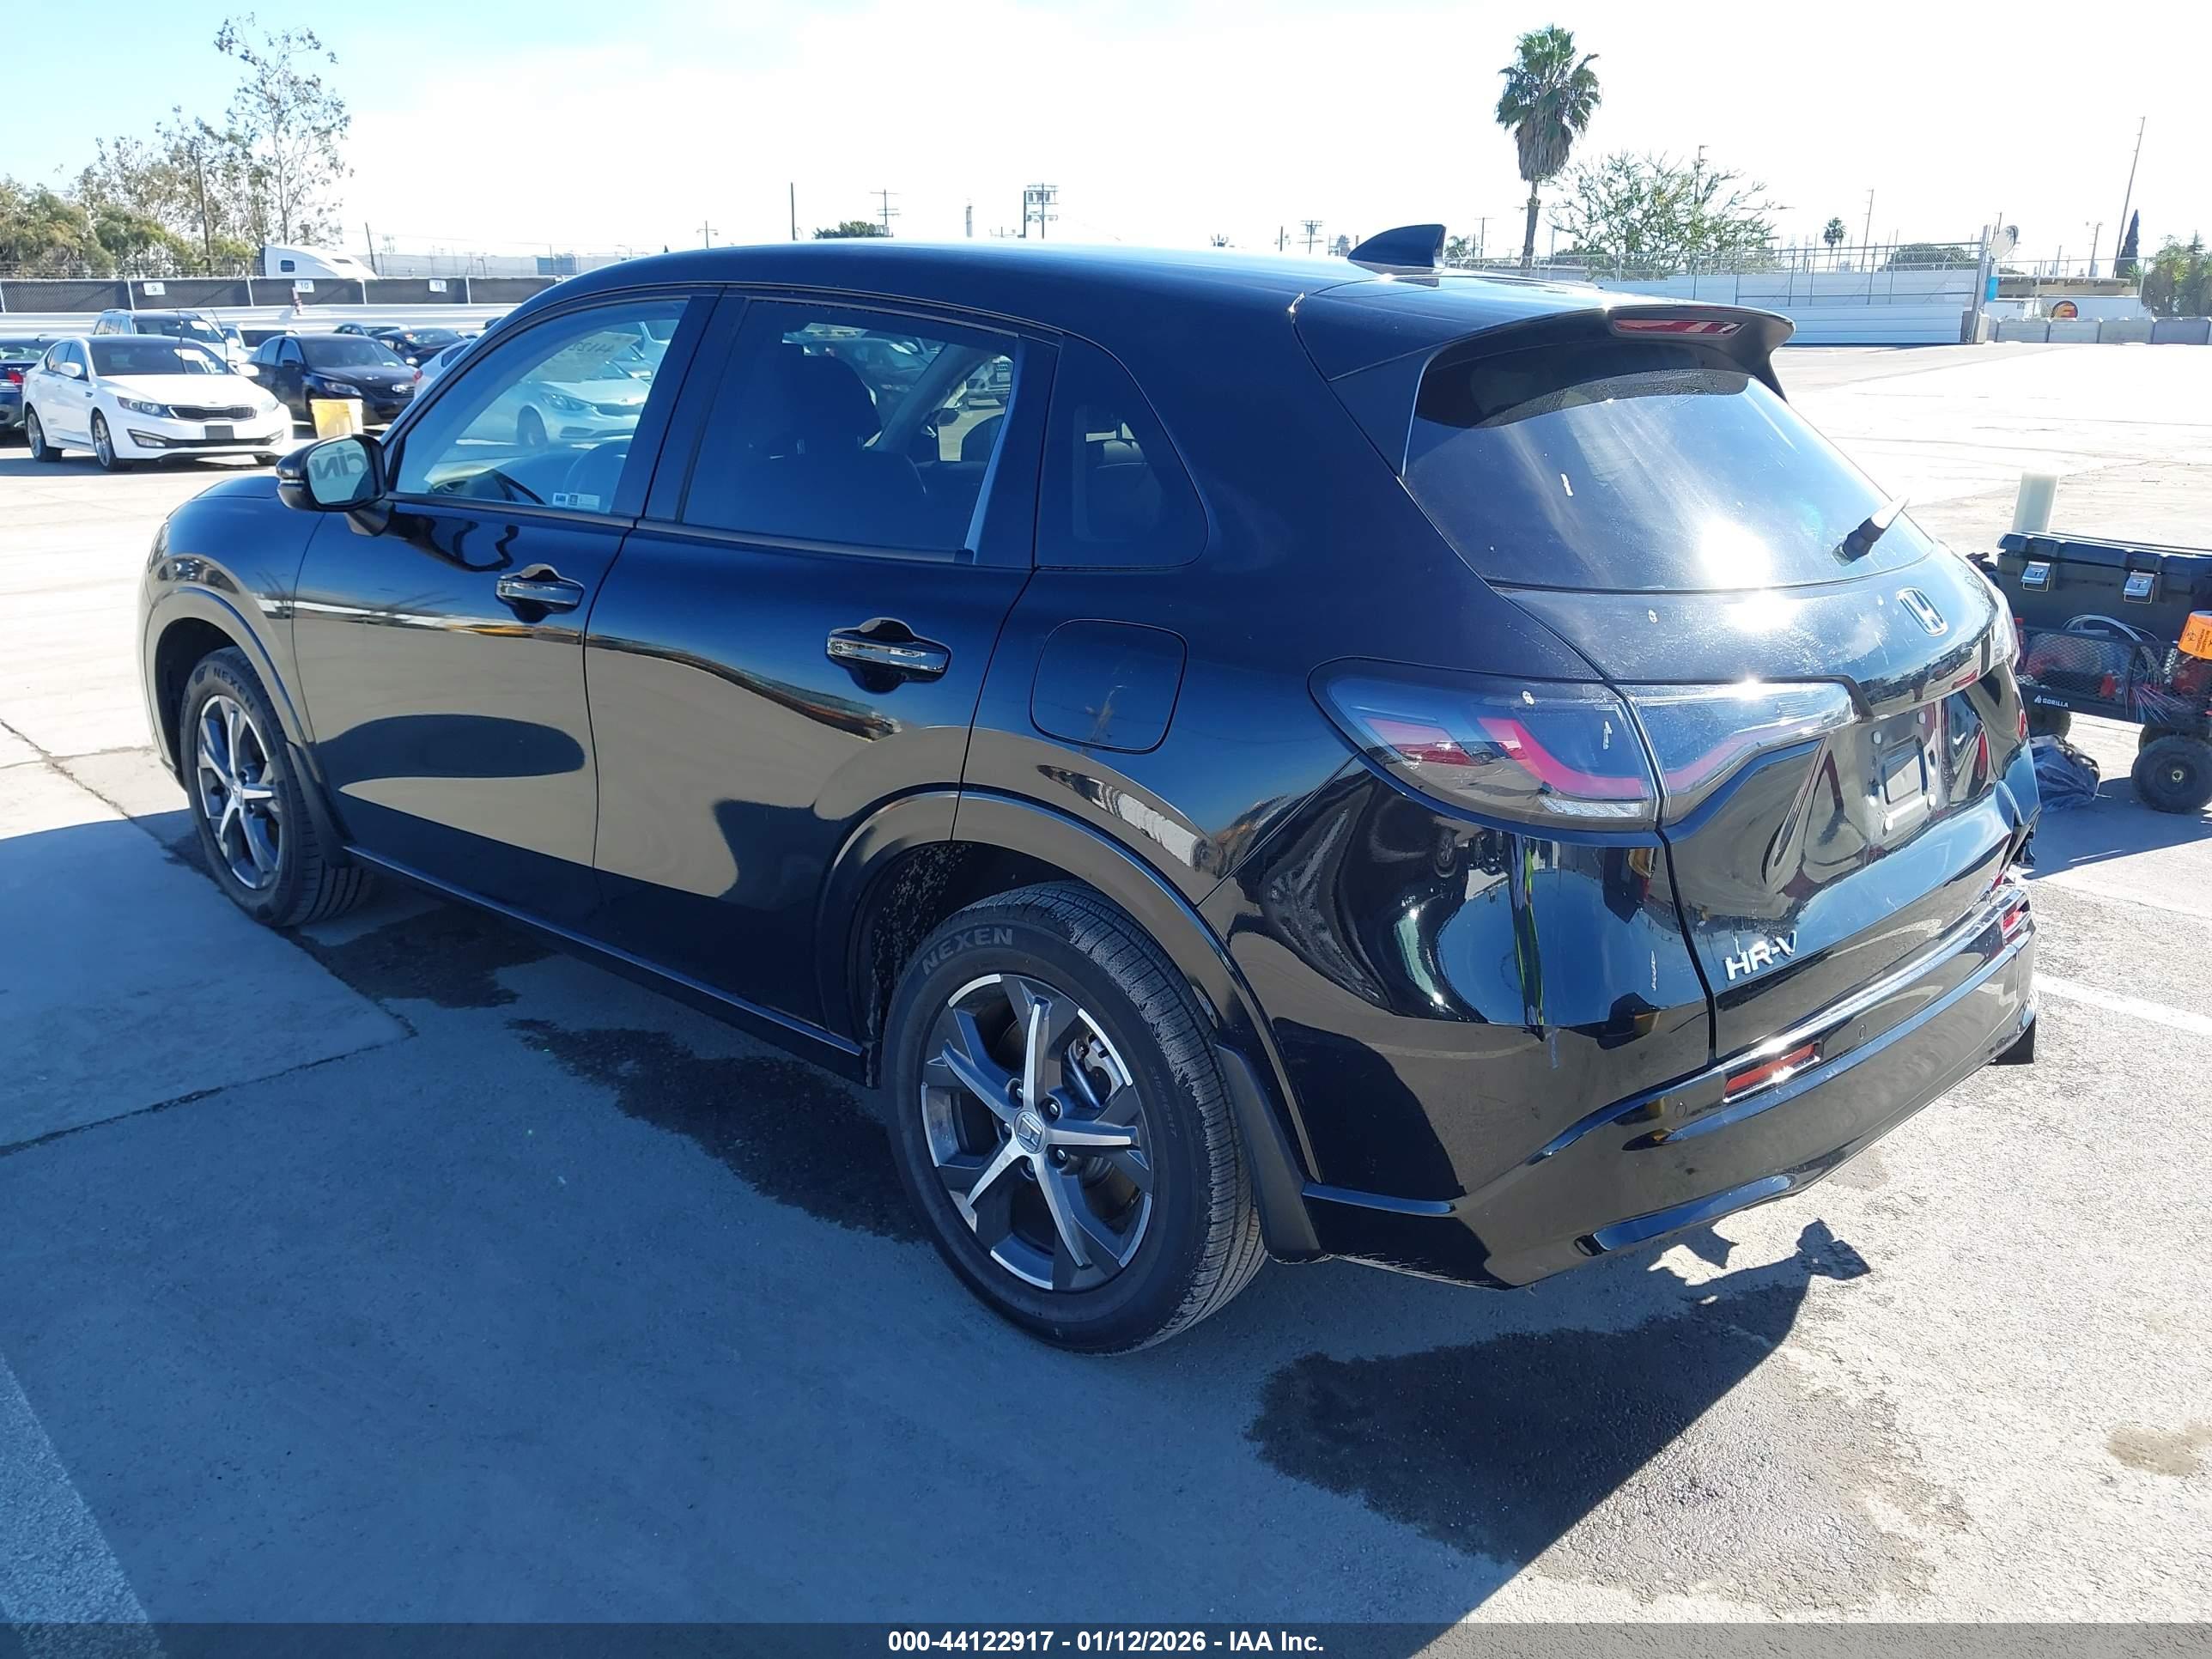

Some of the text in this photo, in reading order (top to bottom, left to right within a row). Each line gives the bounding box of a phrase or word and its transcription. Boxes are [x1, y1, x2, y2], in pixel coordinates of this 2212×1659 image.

[2043, 697, 2069, 708] GORILLA
[922, 927, 1012, 975] NEXEN
[1725, 930, 1797, 981] HR-V
